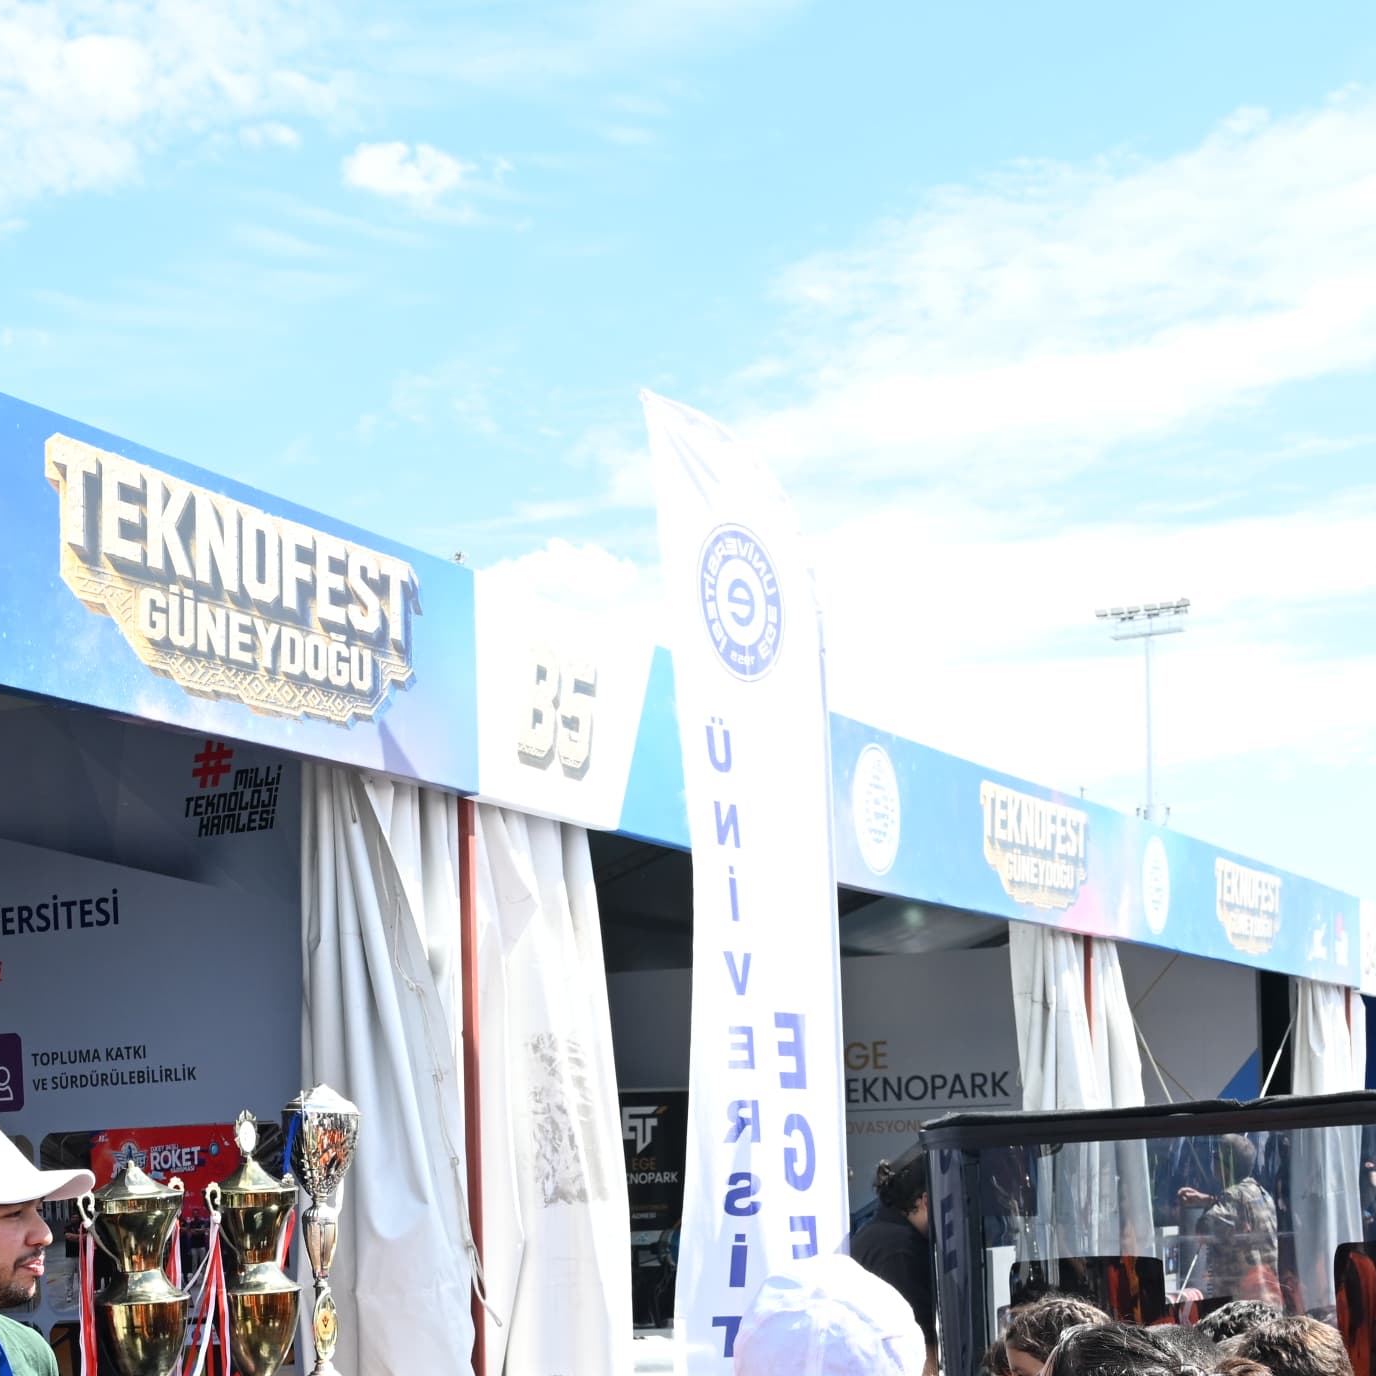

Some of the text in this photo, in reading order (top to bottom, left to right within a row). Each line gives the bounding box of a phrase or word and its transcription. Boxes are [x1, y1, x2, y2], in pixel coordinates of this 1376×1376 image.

[48, 440, 422, 646] TEKNOFEST
[140, 583, 372, 691] GÜNEYDOĞU
[185, 787, 279, 818] TEKNOLOJİ
[198, 808, 276, 837] HAMLESİ
[982, 792, 1087, 858] TEKNOFEST
[31, 1043, 147, 1067] TOPLUMA KATKI
[845, 1041, 888, 1071] GE
[32, 1063, 197, 1092] VE SÜRDÜRÜLEBİLİRLİK
[846, 1071, 1010, 1103] EKNOPARK
[846, 1119, 923, 1135] OVASYON
[150, 1146, 201, 1170] ROKET
[631, 1156, 657, 1171] EGE
